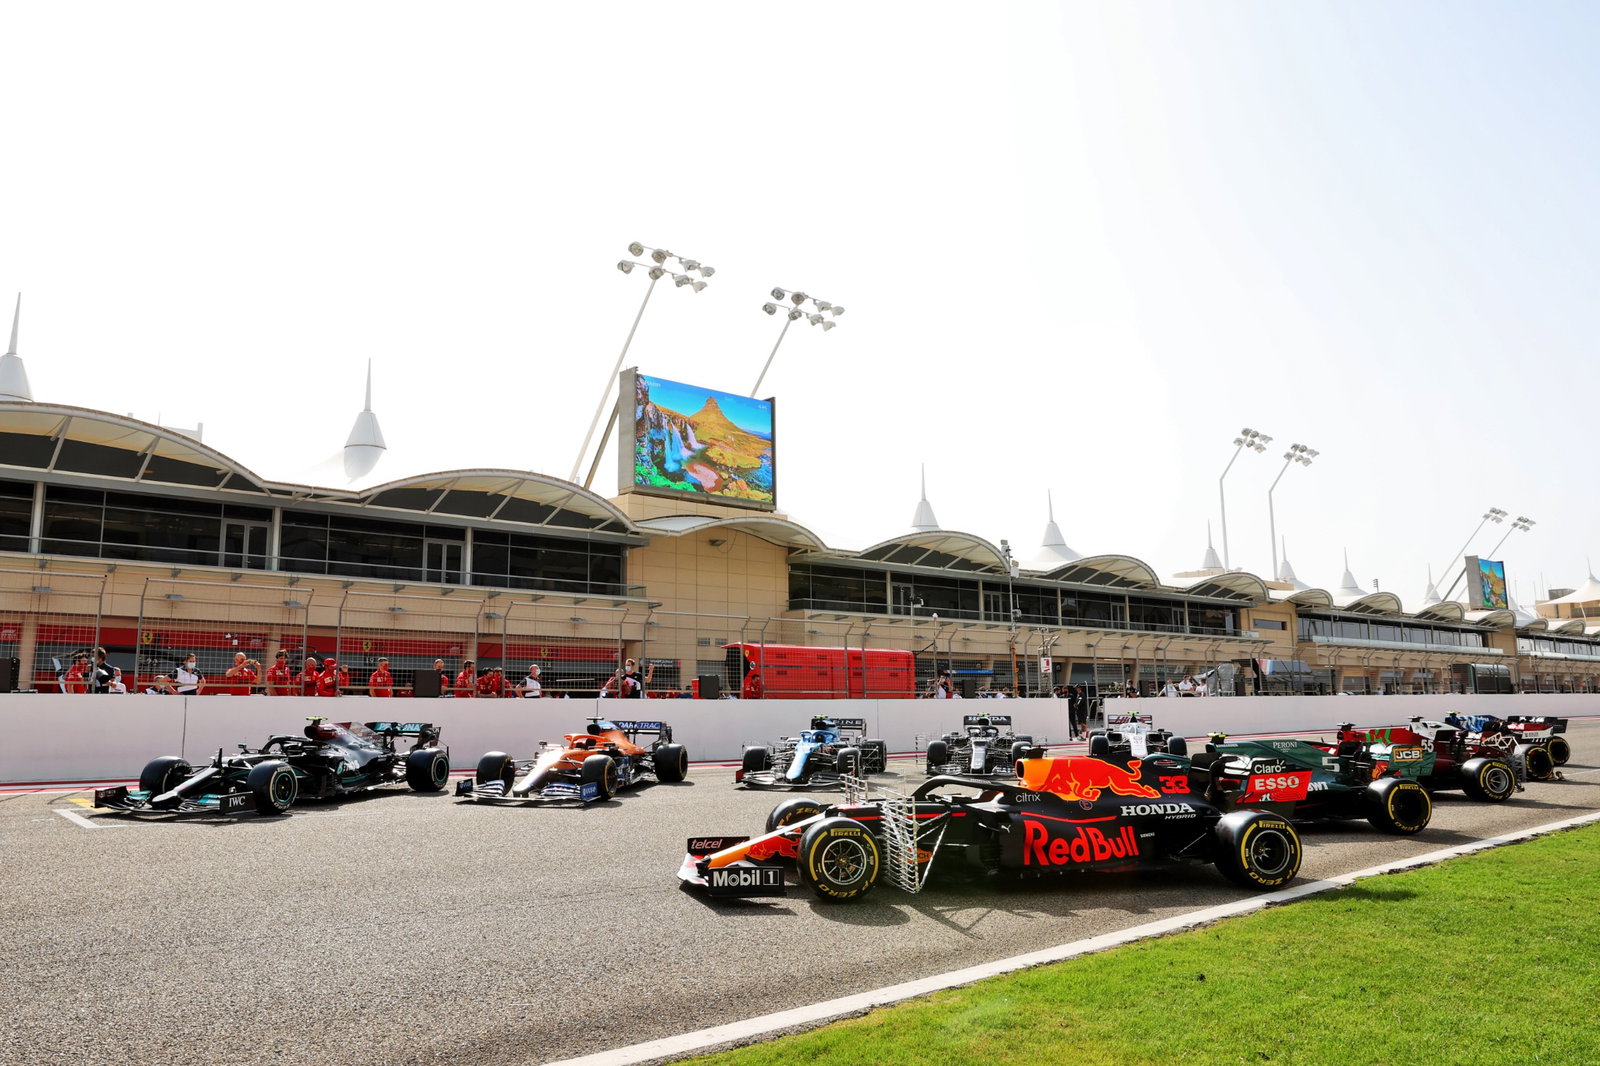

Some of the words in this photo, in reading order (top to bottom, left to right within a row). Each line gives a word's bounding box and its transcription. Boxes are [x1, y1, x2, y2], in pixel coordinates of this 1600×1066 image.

[1273, 741, 1297, 749] PERONI
[1421, 739, 1434, 752] 55
[1397, 751, 1420, 759] JCB
[1322, 757, 1340, 772] 5
[1159, 776, 1191, 794] 33
[1255, 776, 1299, 791] ESSO
[229, 796, 246, 807] IWC
[1120, 803, 1196, 816] HONDA
[1259, 821, 1286, 829] PIRELLI
[830, 828, 861, 837] PIRELLI
[691, 839, 723, 849] telcel
[713, 869, 760, 887] Mobil
[818, 883, 858, 898] ZERO
